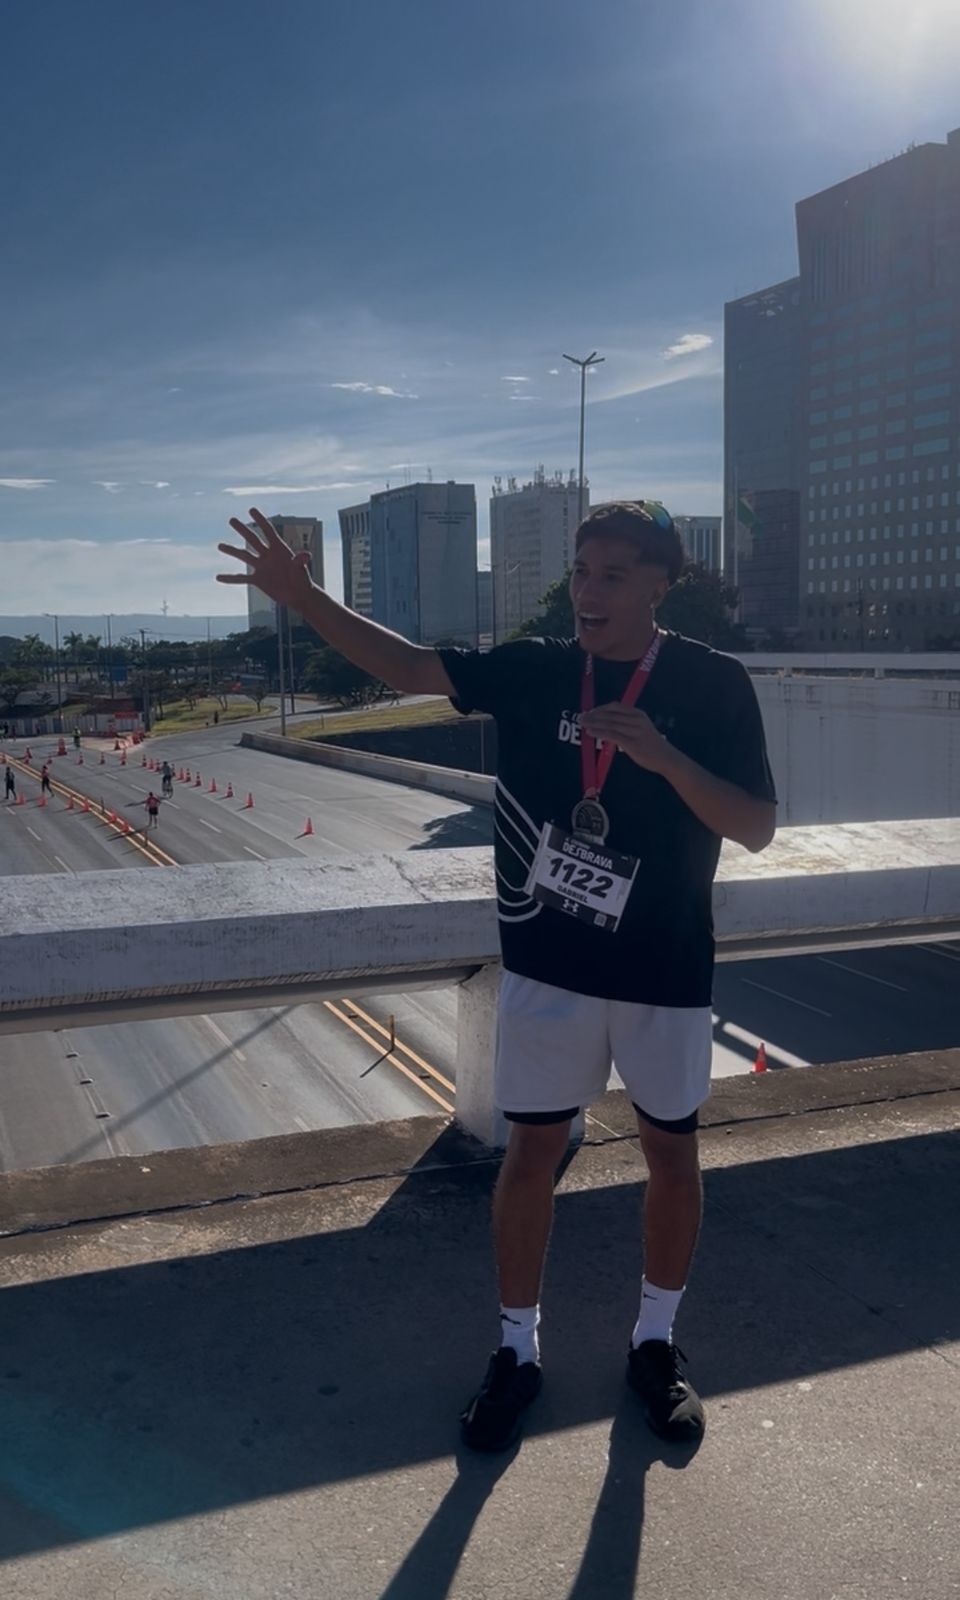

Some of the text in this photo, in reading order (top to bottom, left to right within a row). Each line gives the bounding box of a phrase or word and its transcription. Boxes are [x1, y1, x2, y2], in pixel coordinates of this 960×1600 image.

[561, 841, 613, 870] DESBRAVA
[549, 857, 614, 899] 1122
[556, 884, 588, 904] GABRIEL
